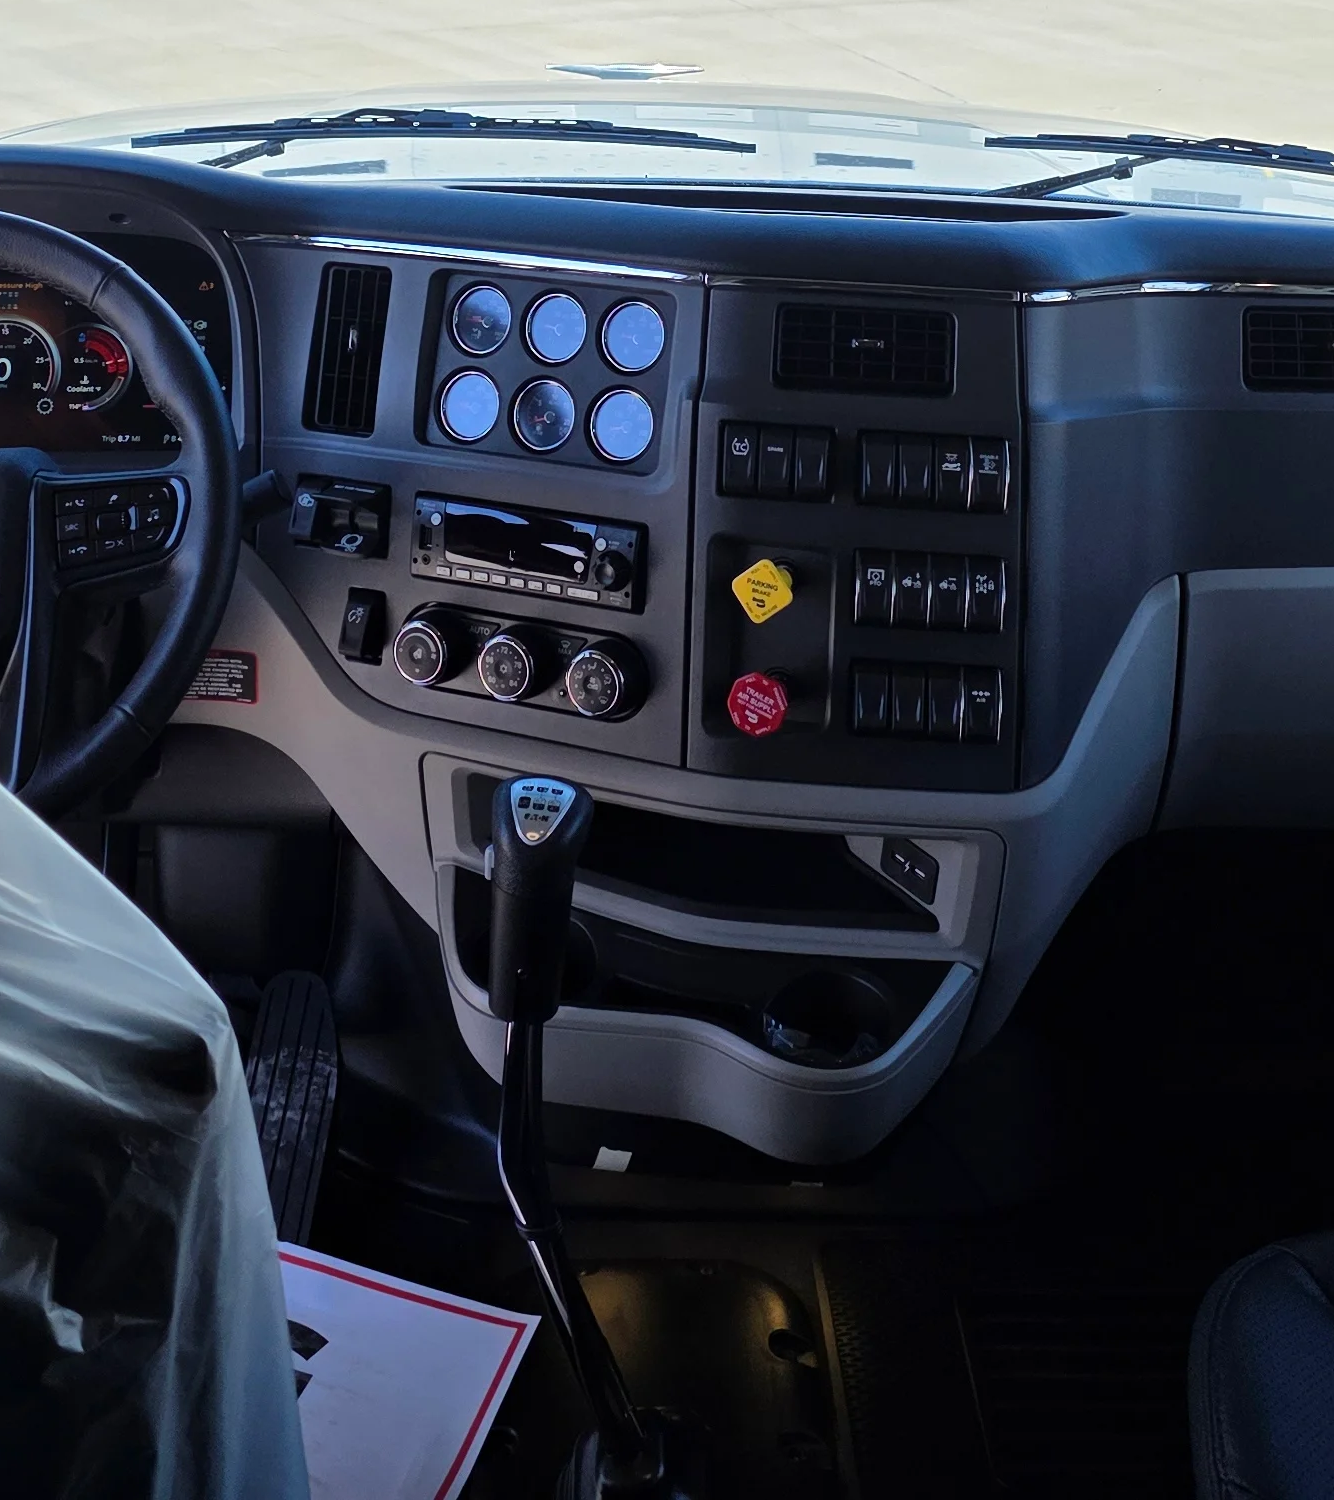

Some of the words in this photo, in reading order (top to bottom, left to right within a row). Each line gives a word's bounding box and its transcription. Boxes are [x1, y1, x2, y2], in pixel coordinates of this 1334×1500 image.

[25, 282, 43, 291] High
[101, 435, 116, 444] Trip
[734, 441, 748, 452] TC
[64, 522, 80, 532] SRC
[747, 577, 779, 592] PARKING
[751, 587, 771, 597] BRAKE
[469, 625, 491, 636] AUTO
[746, 686, 775, 706] TRAILER
[737, 691, 750, 702] AIR
[749, 697, 778, 716] SUPPLY
